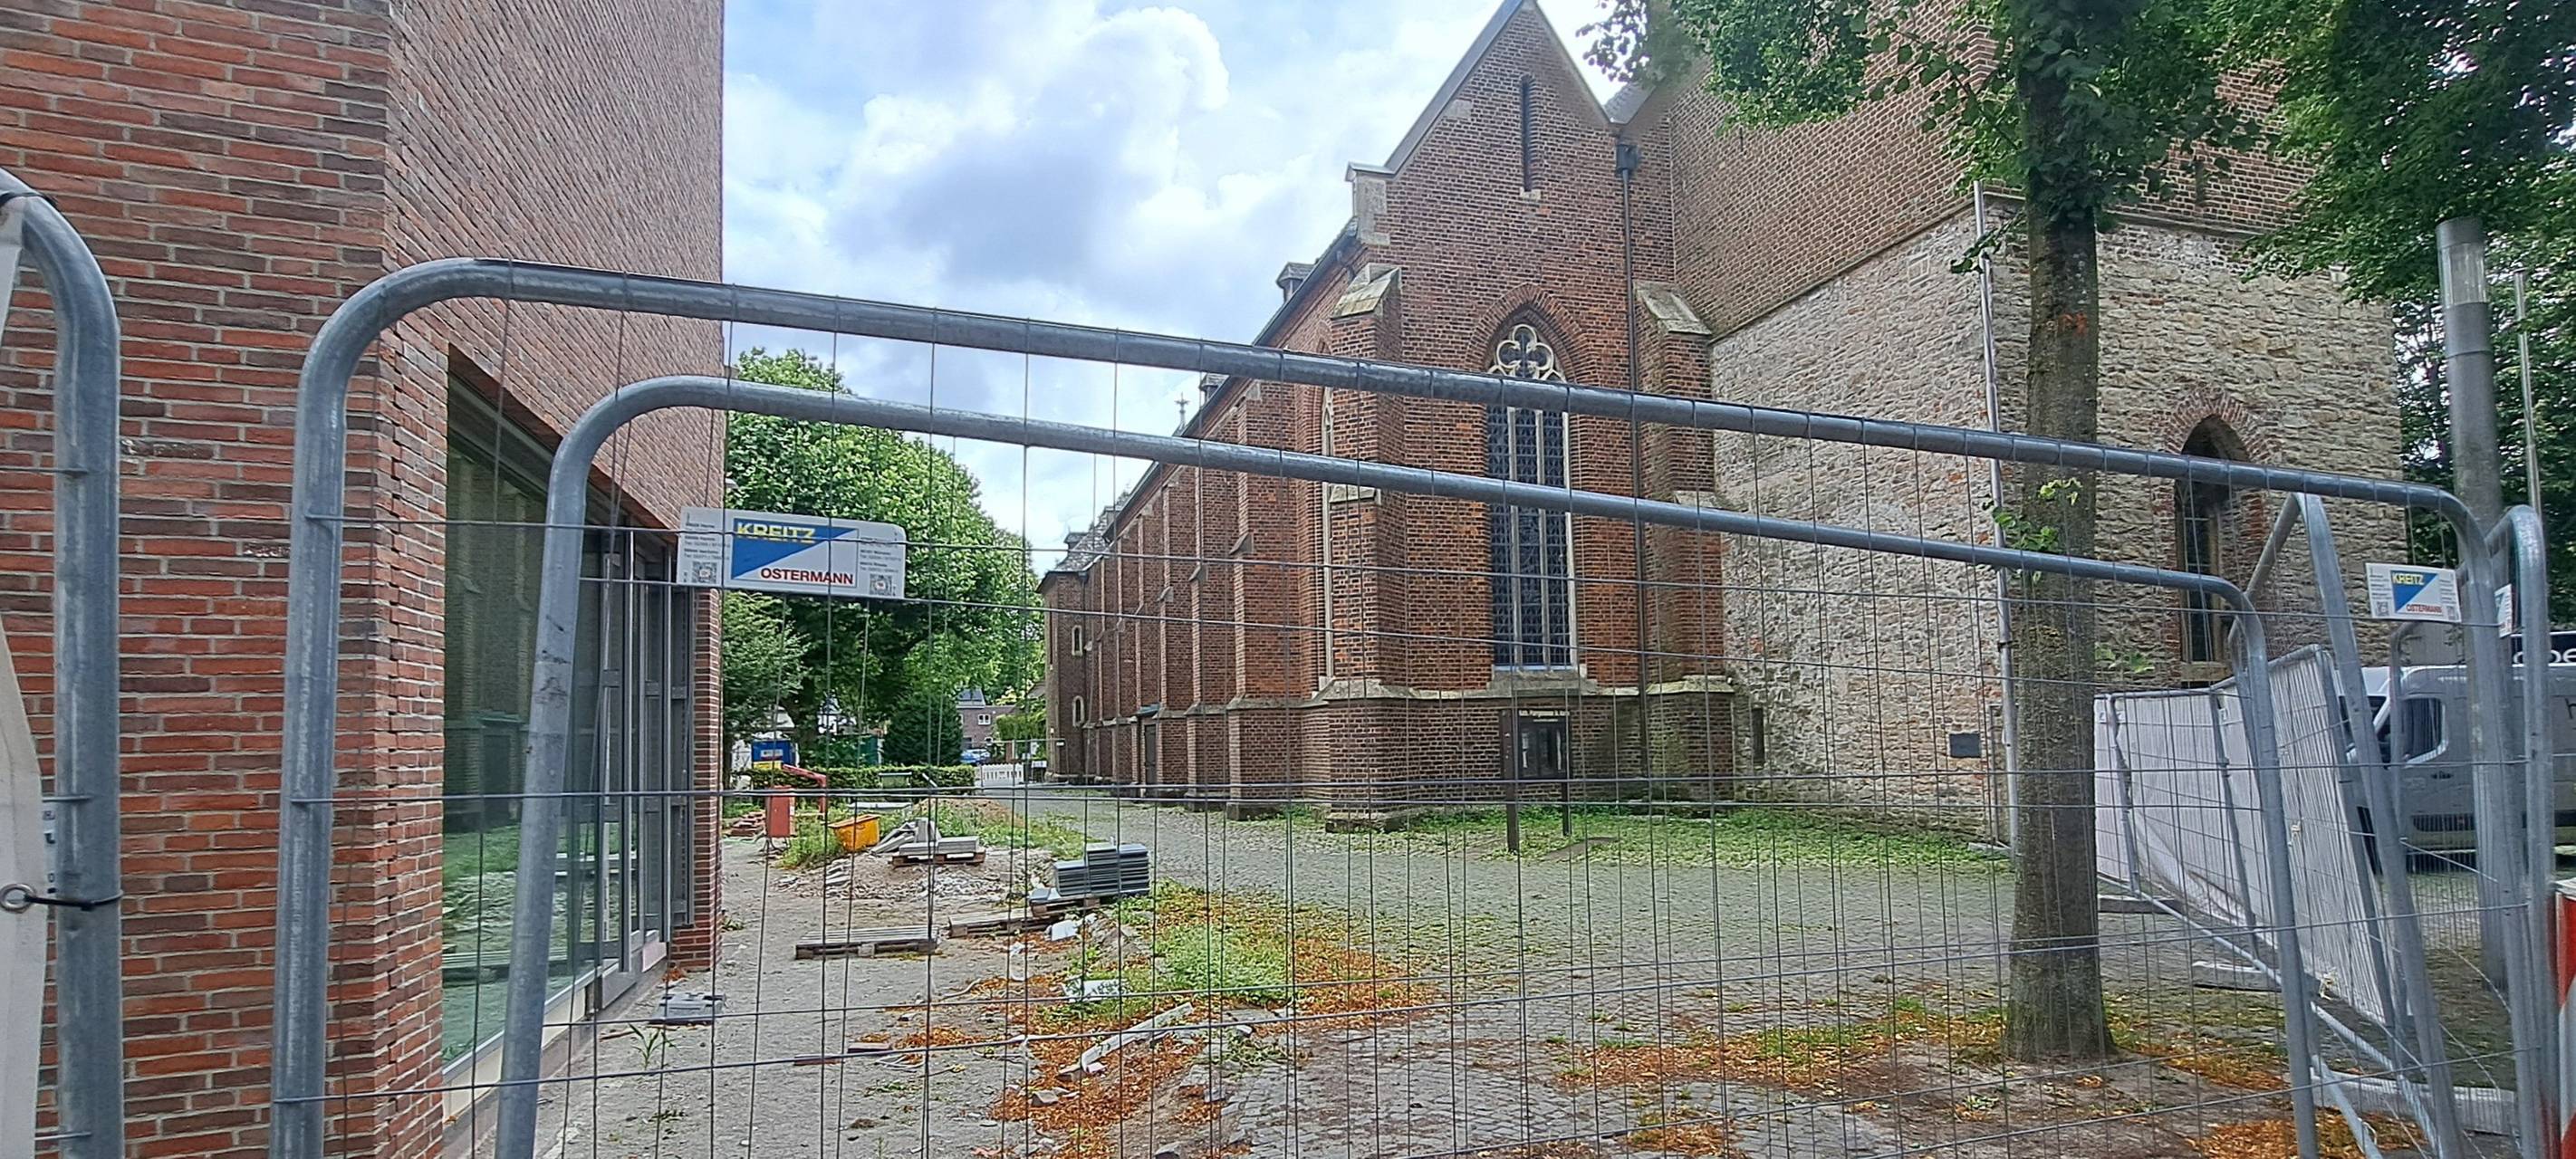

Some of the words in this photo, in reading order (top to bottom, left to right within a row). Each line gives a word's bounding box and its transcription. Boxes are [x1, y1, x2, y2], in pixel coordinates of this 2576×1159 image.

[736, 522, 816, 543] KREITZ
[760, 568, 854, 585] OSTERMANN
[2392, 572, 2425, 585] KREITZ
